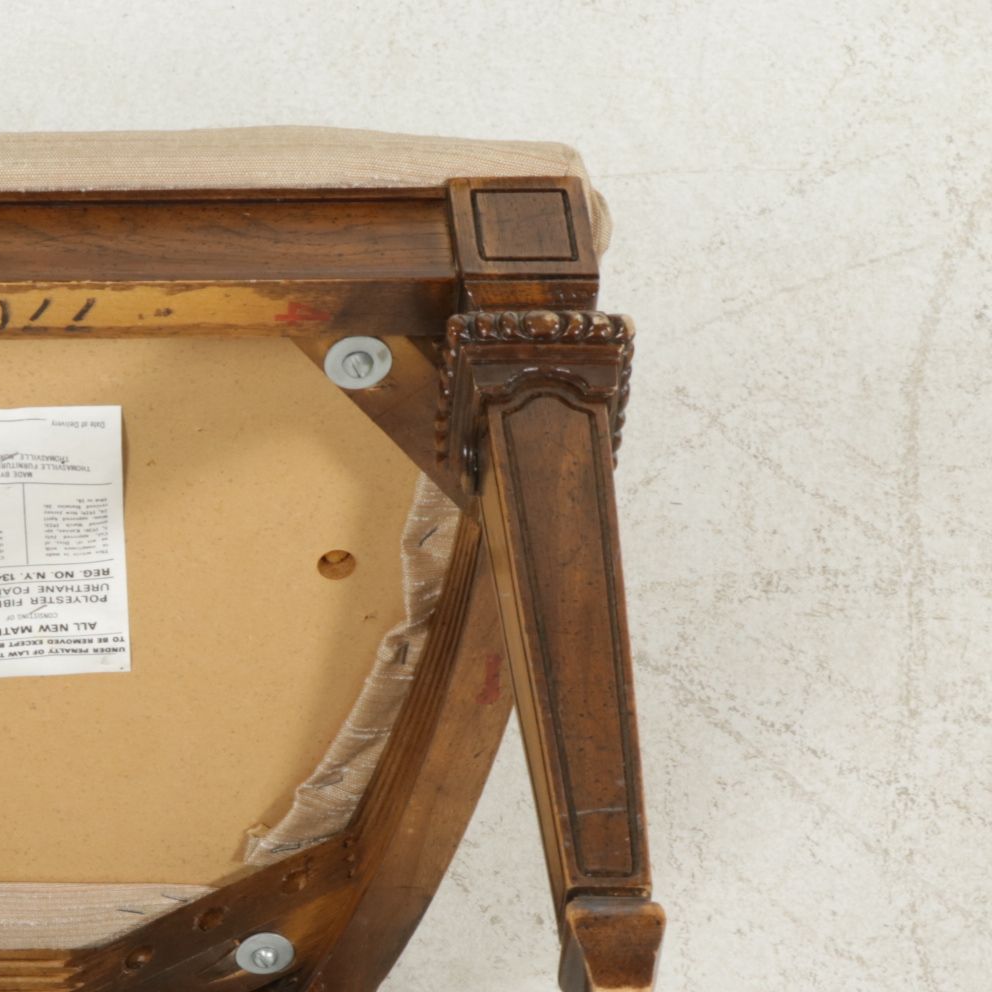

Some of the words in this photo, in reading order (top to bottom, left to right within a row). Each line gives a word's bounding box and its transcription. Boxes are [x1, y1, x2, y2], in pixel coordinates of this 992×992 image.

[20, 572, 47, 581] N.Y.
[51, 570, 75, 579] NO.
[80, 567, 111, 577] REG.
[37, 583, 110, 593] URETHANE
[30, 594, 109, 606] POLYESTER
[38, 623, 69, 633] NEW
[73, 621, 98, 631] ALL
[9, 639, 44, 647] EXCEPT
[47, 637, 94, 645] REMOVED
[8, 649, 30, 657] LAW
